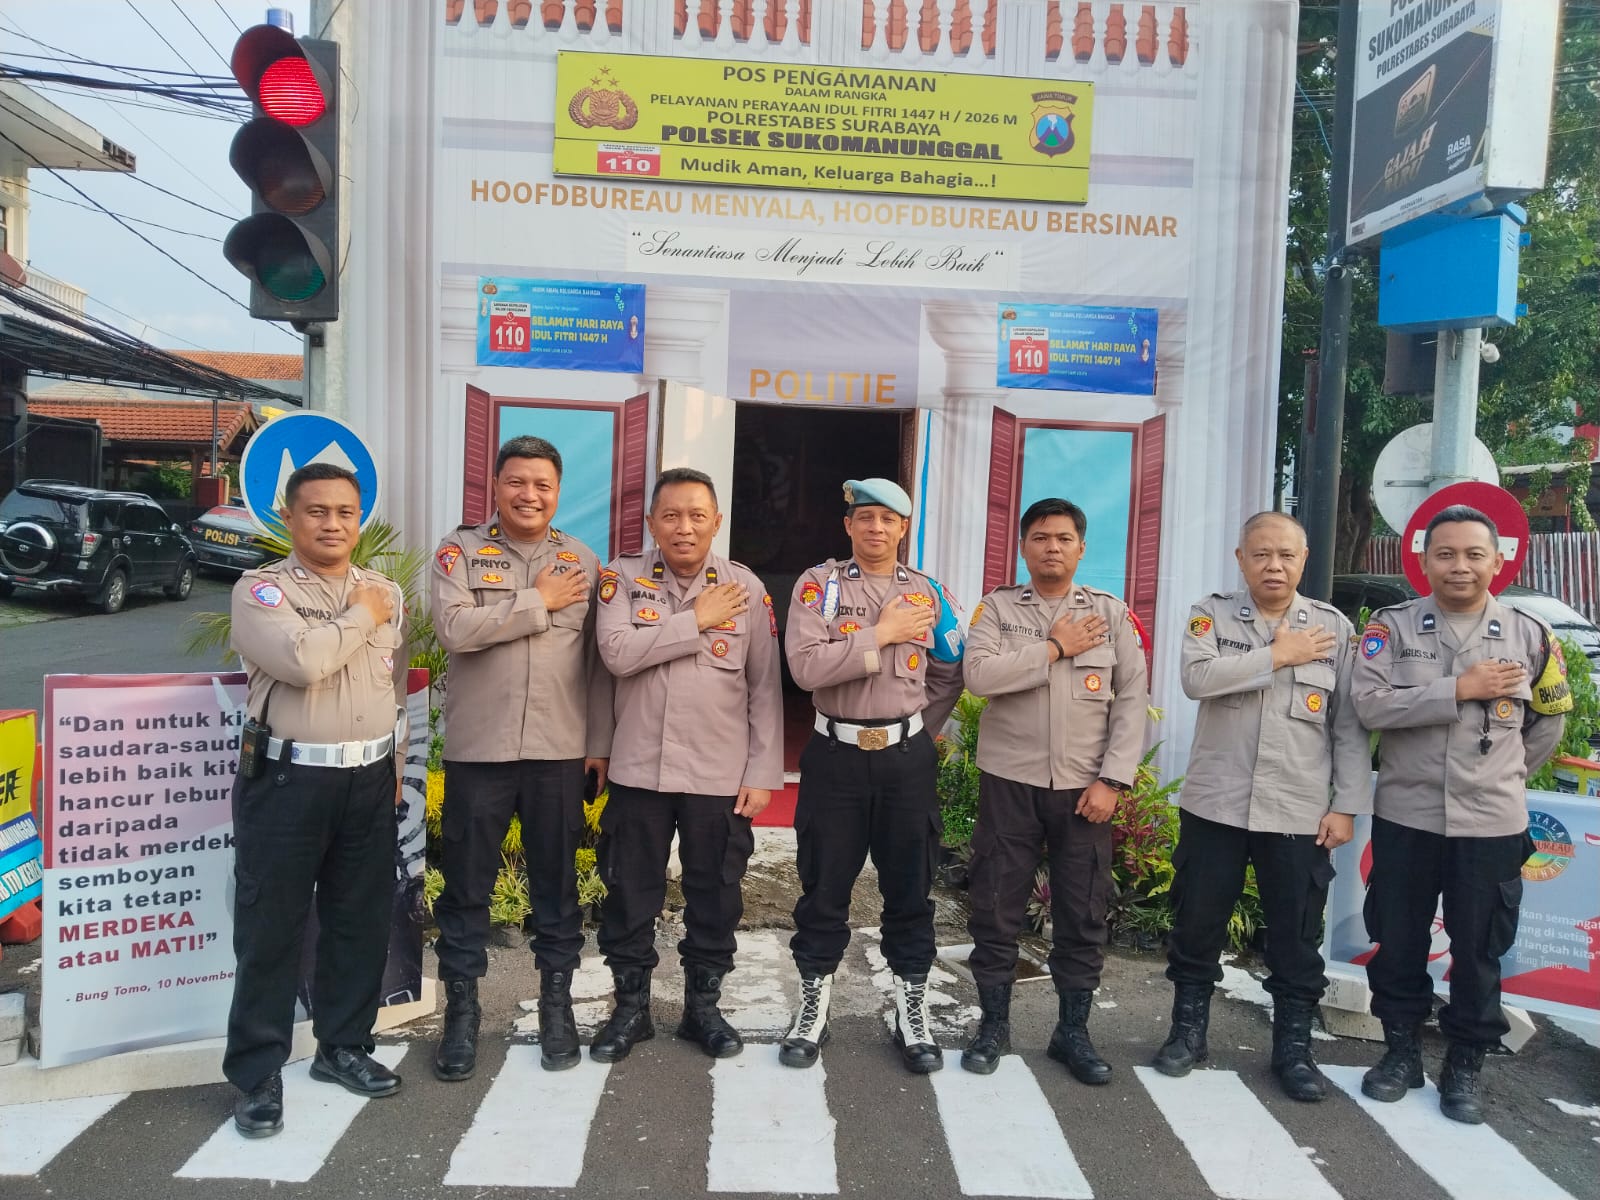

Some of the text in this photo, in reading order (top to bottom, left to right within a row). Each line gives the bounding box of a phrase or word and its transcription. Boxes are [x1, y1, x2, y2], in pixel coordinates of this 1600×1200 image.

[1368, 0, 1458, 61] SUKOMANU
[1376, 1, 1476, 79] POLRESTABES SURABAYA
[723, 66, 937, 92] POS PENGAMANAN
[785, 87, 887, 101] DALAM RANGKA
[650, 94, 1018, 126] PELAYANAN PERAYAAN IDUL FITRI 1447 H / 2026 M
[707, 110, 941, 136] POLRESTABES SURABAYA
[661, 125, 1003, 161] POLSEK SUKOMANUNGGAL
[1447, 134, 1471, 155] RASA
[605, 157, 651, 172] 110
[681, 157, 741, 174] Mudik
[746, 162, 808, 180] Aman,
[814, 165, 894, 184] Keluarga
[471, 179, 1178, 238] HOOFDBUREAU MENYALA, HOOFDBUREAU BERSINAR
[755, 237, 847, 276] Menjadi
[856, 240, 924, 269] Lebih
[495, 325, 525, 346] 110
[531, 316, 625, 331] SELAMAT HARI RAYA
[531, 330, 608, 343] IDUL FITRI 1447 H
[1049, 339, 1137, 354] SELAMAT HARI RAYA
[1015, 348, 1043, 369] 110
[1049, 352, 1121, 366] IDUL FITRI 1447 H
[750, 368, 897, 404] POLITIE
[205, 528, 239, 546] POLISI
[471, 558, 511, 570] PRIYO
[59, 711, 246, 733] “Dan untuk ki
[59, 735, 240, 759] saudara-saud
[59, 759, 238, 785] lebih baik kit
[59, 786, 231, 811] hancur lebur
[58, 814, 179, 838] daripada
[58, 833, 237, 864] tidak merdek
[1534, 841, 1571, 853] UREAU
[58, 864, 195, 890] semboyan
[59, 888, 202, 917] kita tetap:
[59, 911, 195, 943] MERDEKA
[1543, 927, 1555, 938] di
[1557, 931, 1594, 946] setiap
[58, 932, 217, 970] atau MATI!”
[1524, 939, 1570, 956] langkah
[1516, 951, 1538, 967] Bung
[1540, 955, 1563, 970] Tomo
[75, 989, 109, 1003] Bung
[114, 984, 151, 999] Tomo,
[157, 978, 172, 990] 10
[176, 970, 234, 987] Novembe
